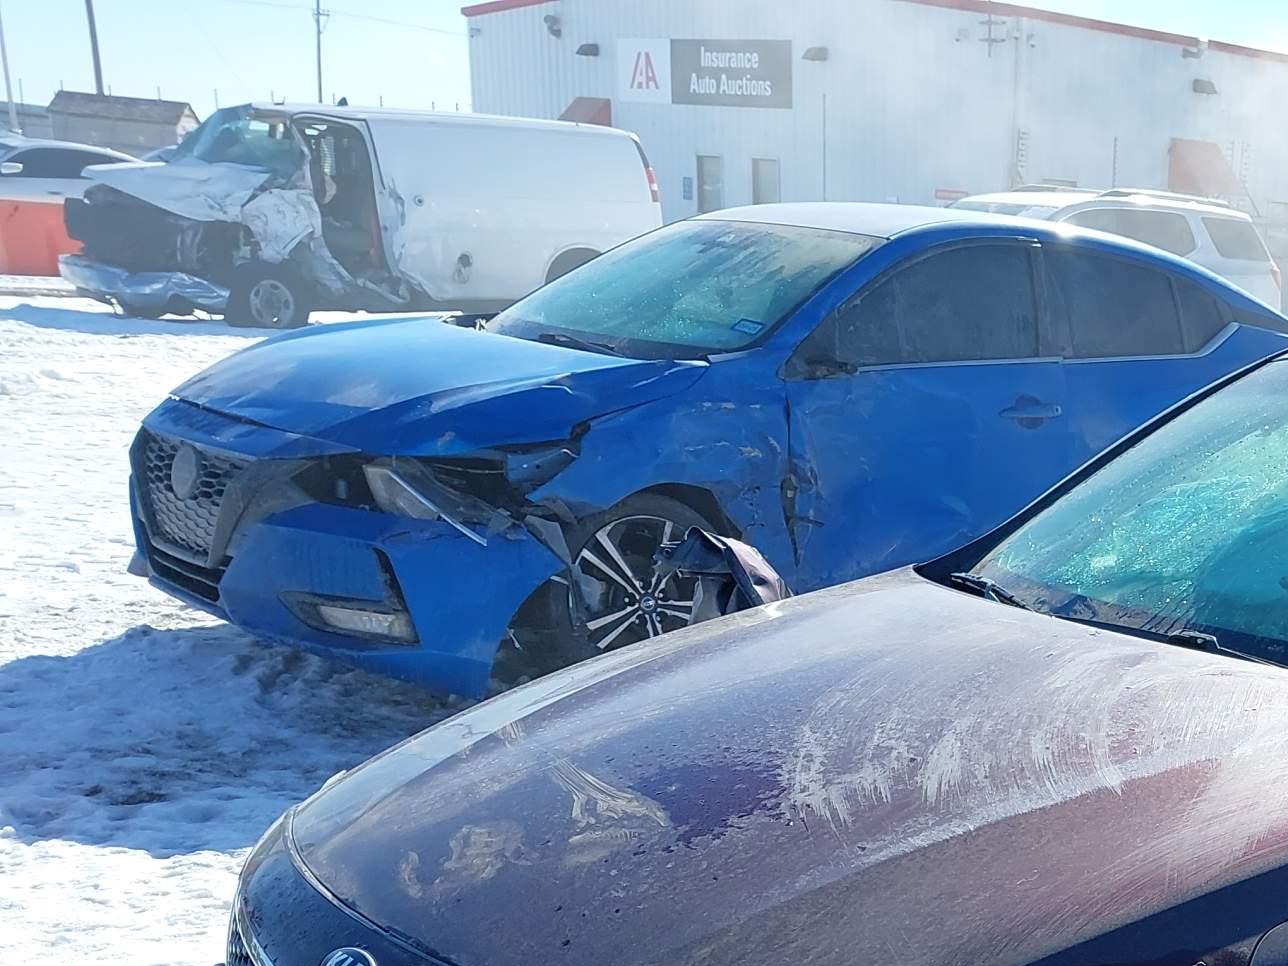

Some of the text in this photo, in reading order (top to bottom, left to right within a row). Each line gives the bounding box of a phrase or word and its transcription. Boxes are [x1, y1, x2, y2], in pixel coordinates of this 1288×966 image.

[700, 46, 759, 68] Insurance
[689, 73, 772, 97] Auto Auctions
